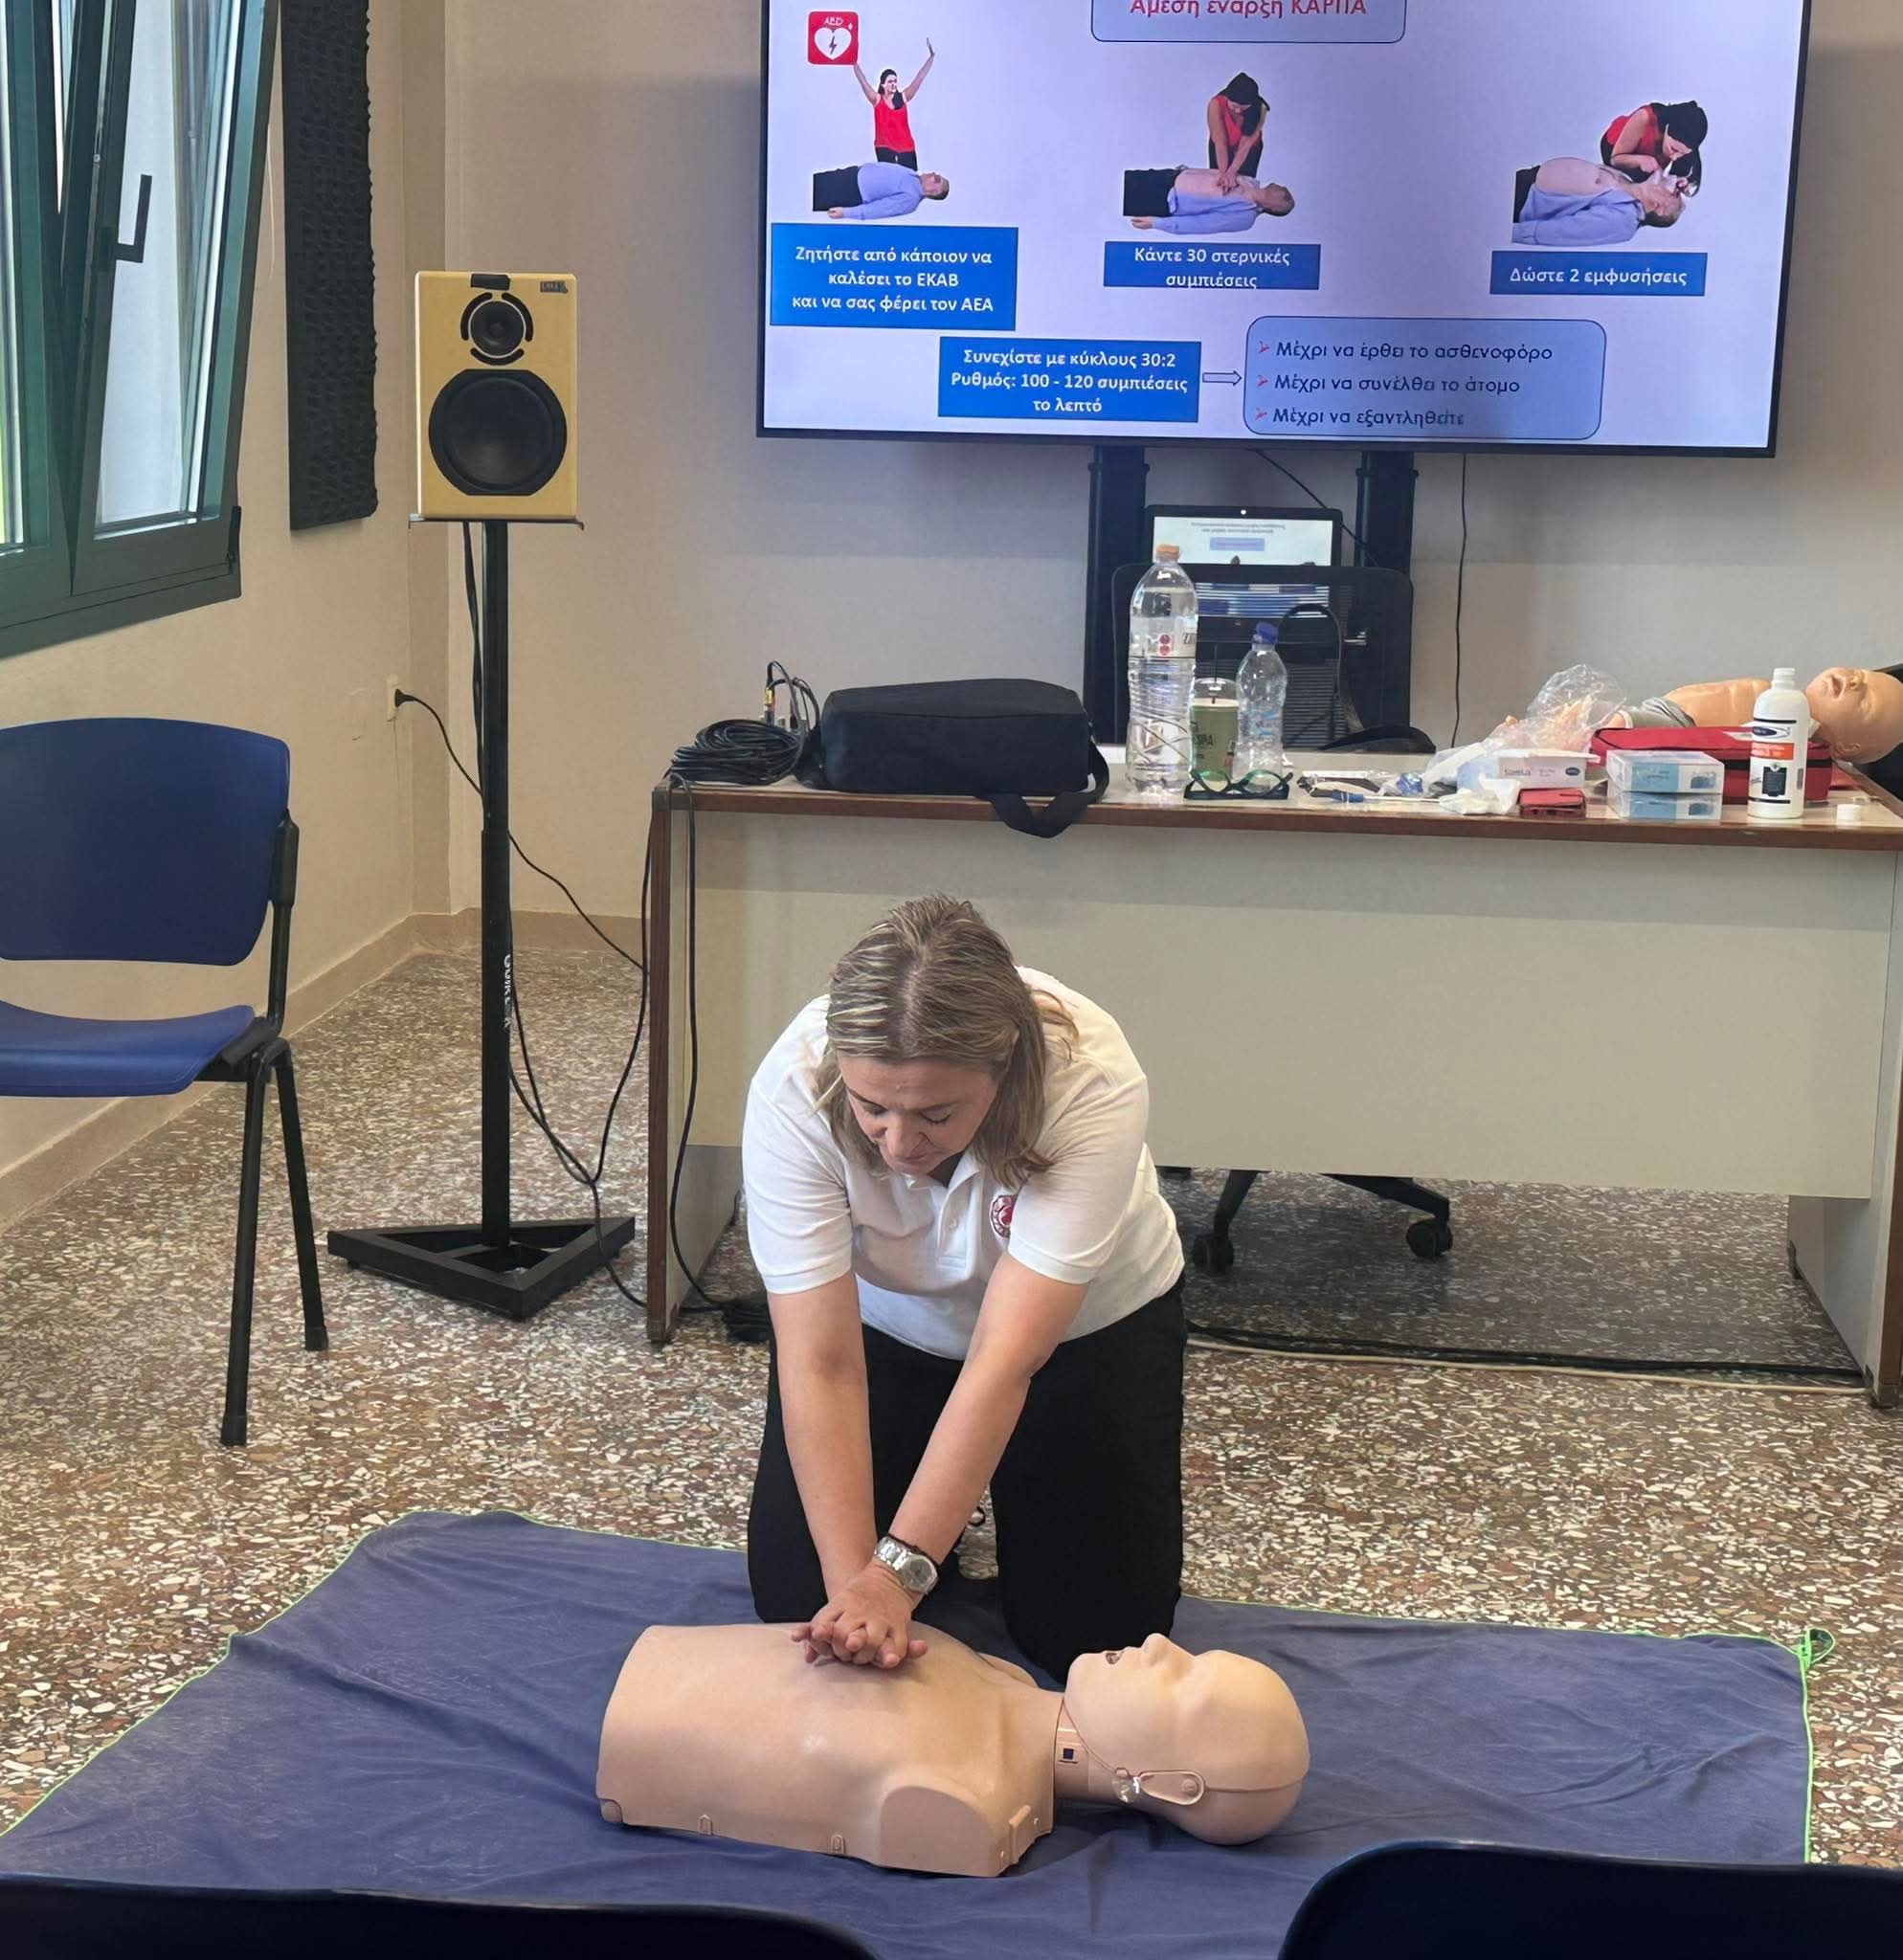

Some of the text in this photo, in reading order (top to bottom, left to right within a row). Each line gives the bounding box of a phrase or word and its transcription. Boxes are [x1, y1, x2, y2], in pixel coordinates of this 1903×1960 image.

[1291, 0, 1367, 14] ΚΑΡΠΑ
[823, 16, 844, 27] AED
[795, 246, 992, 263] Ζητήστε από κάποιον να
[1134, 247, 1289, 266] Κάντε 30 στερνικές
[828, 271, 959, 286] καλέσει το ΕΚΑΒ
[1166, 272, 1257, 289] συμπιέσεις
[1510, 266, 1687, 286] Δώστε 2 εμφυσήσεις
[793, 295, 994, 313] και να σας φέρει τον ΑΕΑ
[964, 348, 1175, 368] Συνεχίστε με κύκλους 30:2
[1276, 340, 1553, 363] Μέχρι να έρθει το ασθενοφόρο
[952, 371, 1016, 389] Ρυθμός:
[1021, 373, 1049, 388] 100
[1064, 374, 1094, 389] 120
[1097, 375, 1188, 393] συμπιέσεις
[1274, 373, 1520, 395] Μέχρι να συνέλθει το άτομο
[1033, 397, 1103, 412] το λεπτό
[1272, 407, 1465, 429] Μέχρι να εξαντληθείτε
